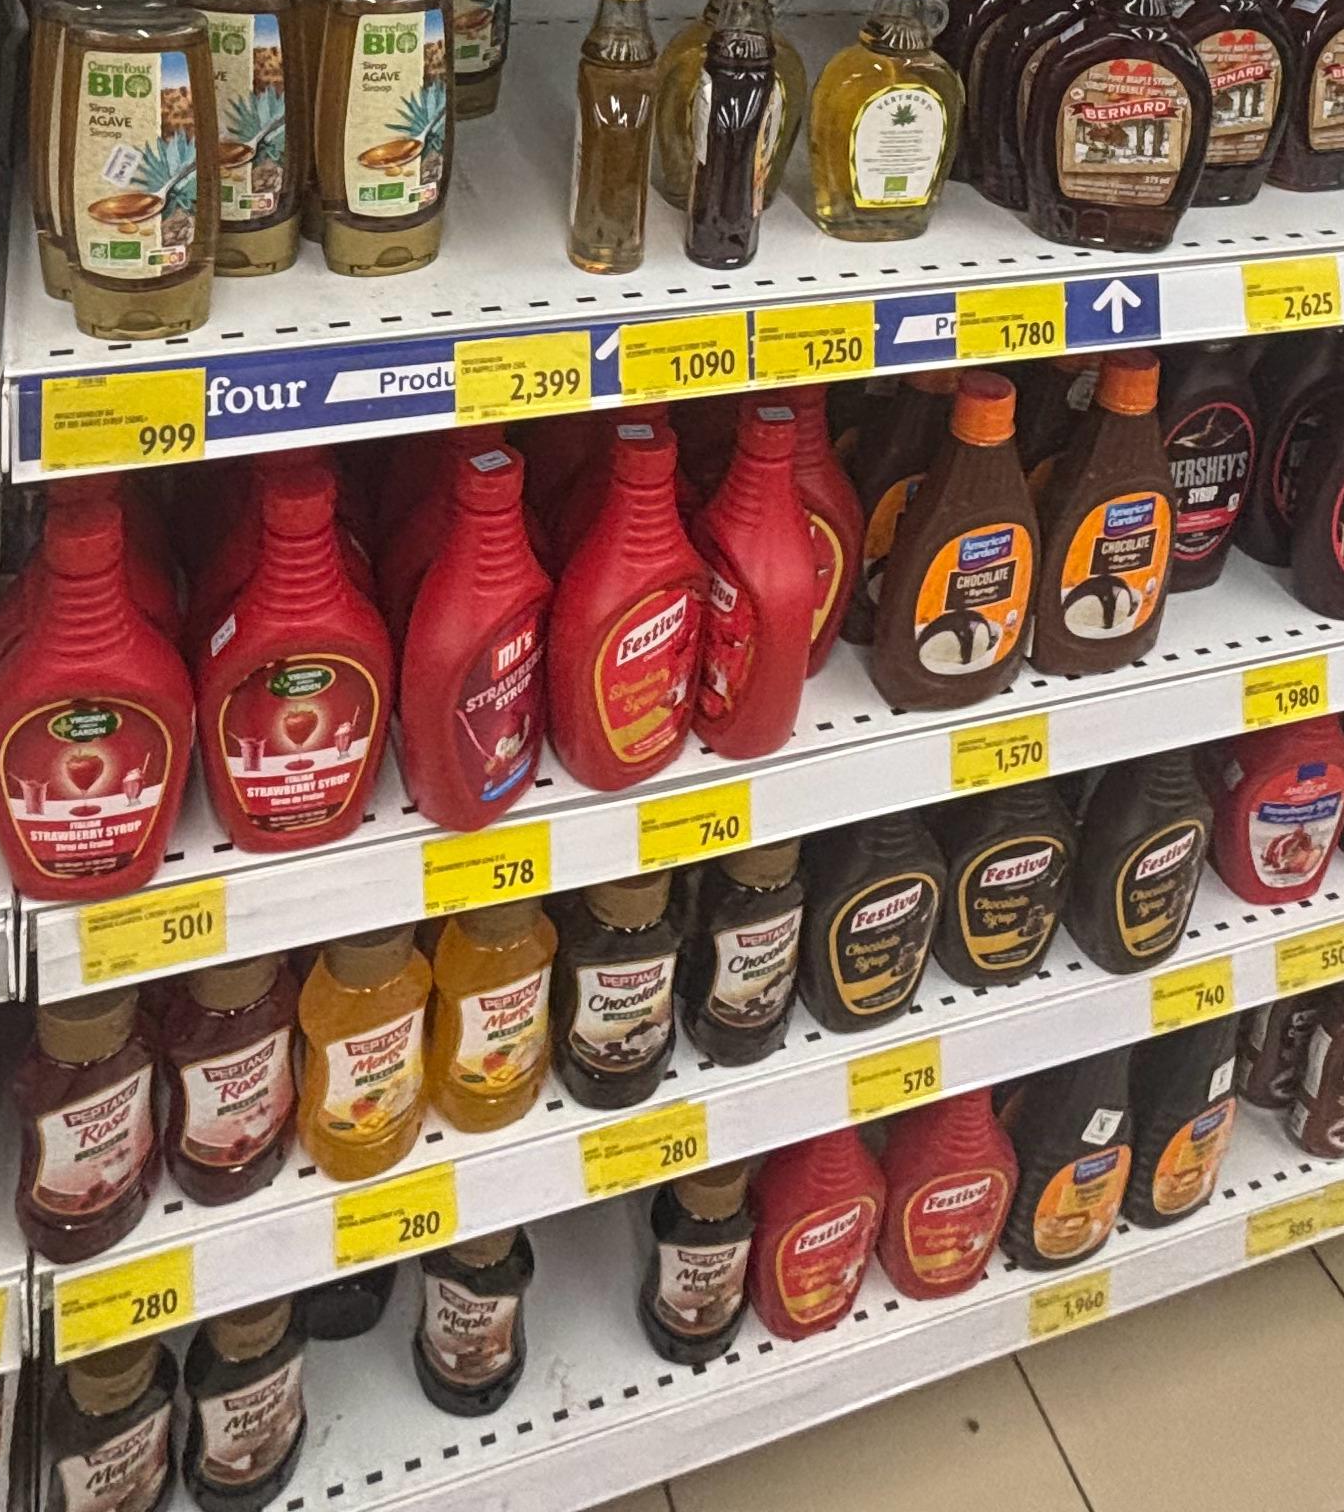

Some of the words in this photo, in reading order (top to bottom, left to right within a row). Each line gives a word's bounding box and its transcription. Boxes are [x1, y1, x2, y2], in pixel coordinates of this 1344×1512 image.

[364, 21, 416, 34] Carrefour
[363, 32, 417, 56] BIO
[88, 61, 152, 75] Carrefour
[363, 71, 400, 82] AGAVE
[88, 72, 152, 98] BIO
[89, 116, 132, 128] AGAVE
[1085, 100, 1167, 120] BERNARD
[1284, 292, 1333, 321] 2,625
[999, 320, 1055, 349] 1,780
[670, 349, 735, 386] 1,090
[803, 337, 863, 371] 1,250
[509, 367, 581, 405] 2,399
[139, 423, 197, 456] 999
[1108, 501, 1154, 518] American
[1188, 485, 1218, 505] SYRUP
[1108, 514, 1144, 529] Garden
[962, 547, 1002, 562] Garden
[963, 534, 1012, 550] American
[1102, 535, 1150, 555] CHOCOLATE
[956, 567, 1009, 589] CHOCOLATE
[620, 604, 686, 661] Festiva
[495, 673, 532, 710] SYRUP
[1275, 684, 1319, 714] 1,980
[995, 741, 1043, 772] 1,570
[247, 781, 316, 799] STRAWBERRY
[317, 772, 352, 792] SYRUP
[30, 826, 104, 843] STRAWBERRY
[105, 820, 143, 840] SYRUP
[699, 814, 740, 845] 740
[985, 854, 1052, 885] Festiva
[1138, 836, 1193, 877] Festiva
[493, 859, 535, 890] 578
[854, 890, 921, 929] Festiva
[161, 911, 214, 944] 500
[588, 977, 667, 1013] Chocolate
[1195, 986, 1225, 1007] 740
[903, 1067, 935, 1093] 578
[659, 1138, 698, 1167] 280
[925, 1180, 989, 1212] Festiva
[398, 1211, 440, 1242] 280
[797, 1210, 859, 1254] Festiva
[677, 1264, 731, 1287] Maple
[130, 1287, 178, 1324] 280
[438, 1305, 493, 1329] Maple
